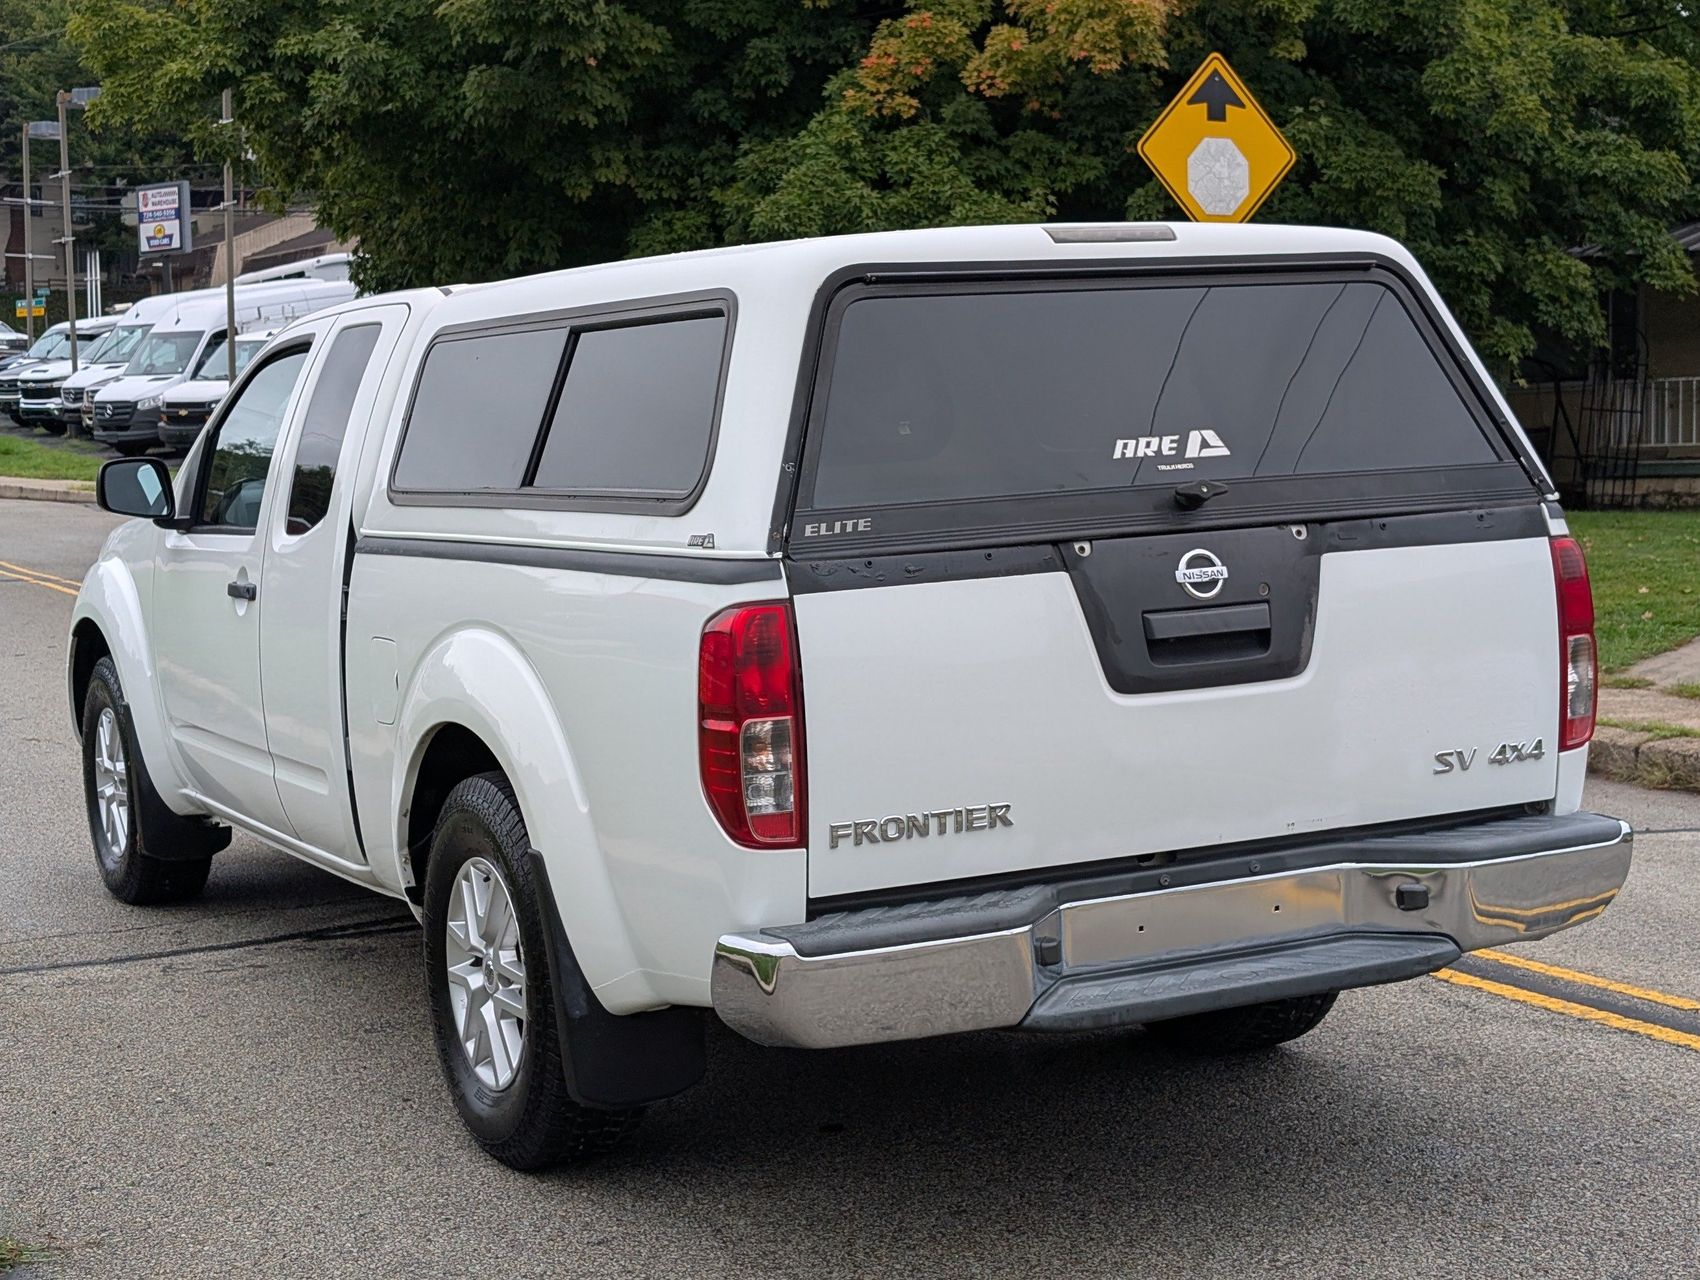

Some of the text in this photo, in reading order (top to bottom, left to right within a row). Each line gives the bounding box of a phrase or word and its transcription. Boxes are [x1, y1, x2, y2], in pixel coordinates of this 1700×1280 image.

[151, 199, 177, 207] WAREHOUSE
[1113, 435, 1180, 459] ARE
[804, 518, 872, 537] ELITE
[1182, 569, 1224, 580] NISSAN
[1433, 746, 1478, 775] SV
[829, 802, 1014, 849] FRONTIER
